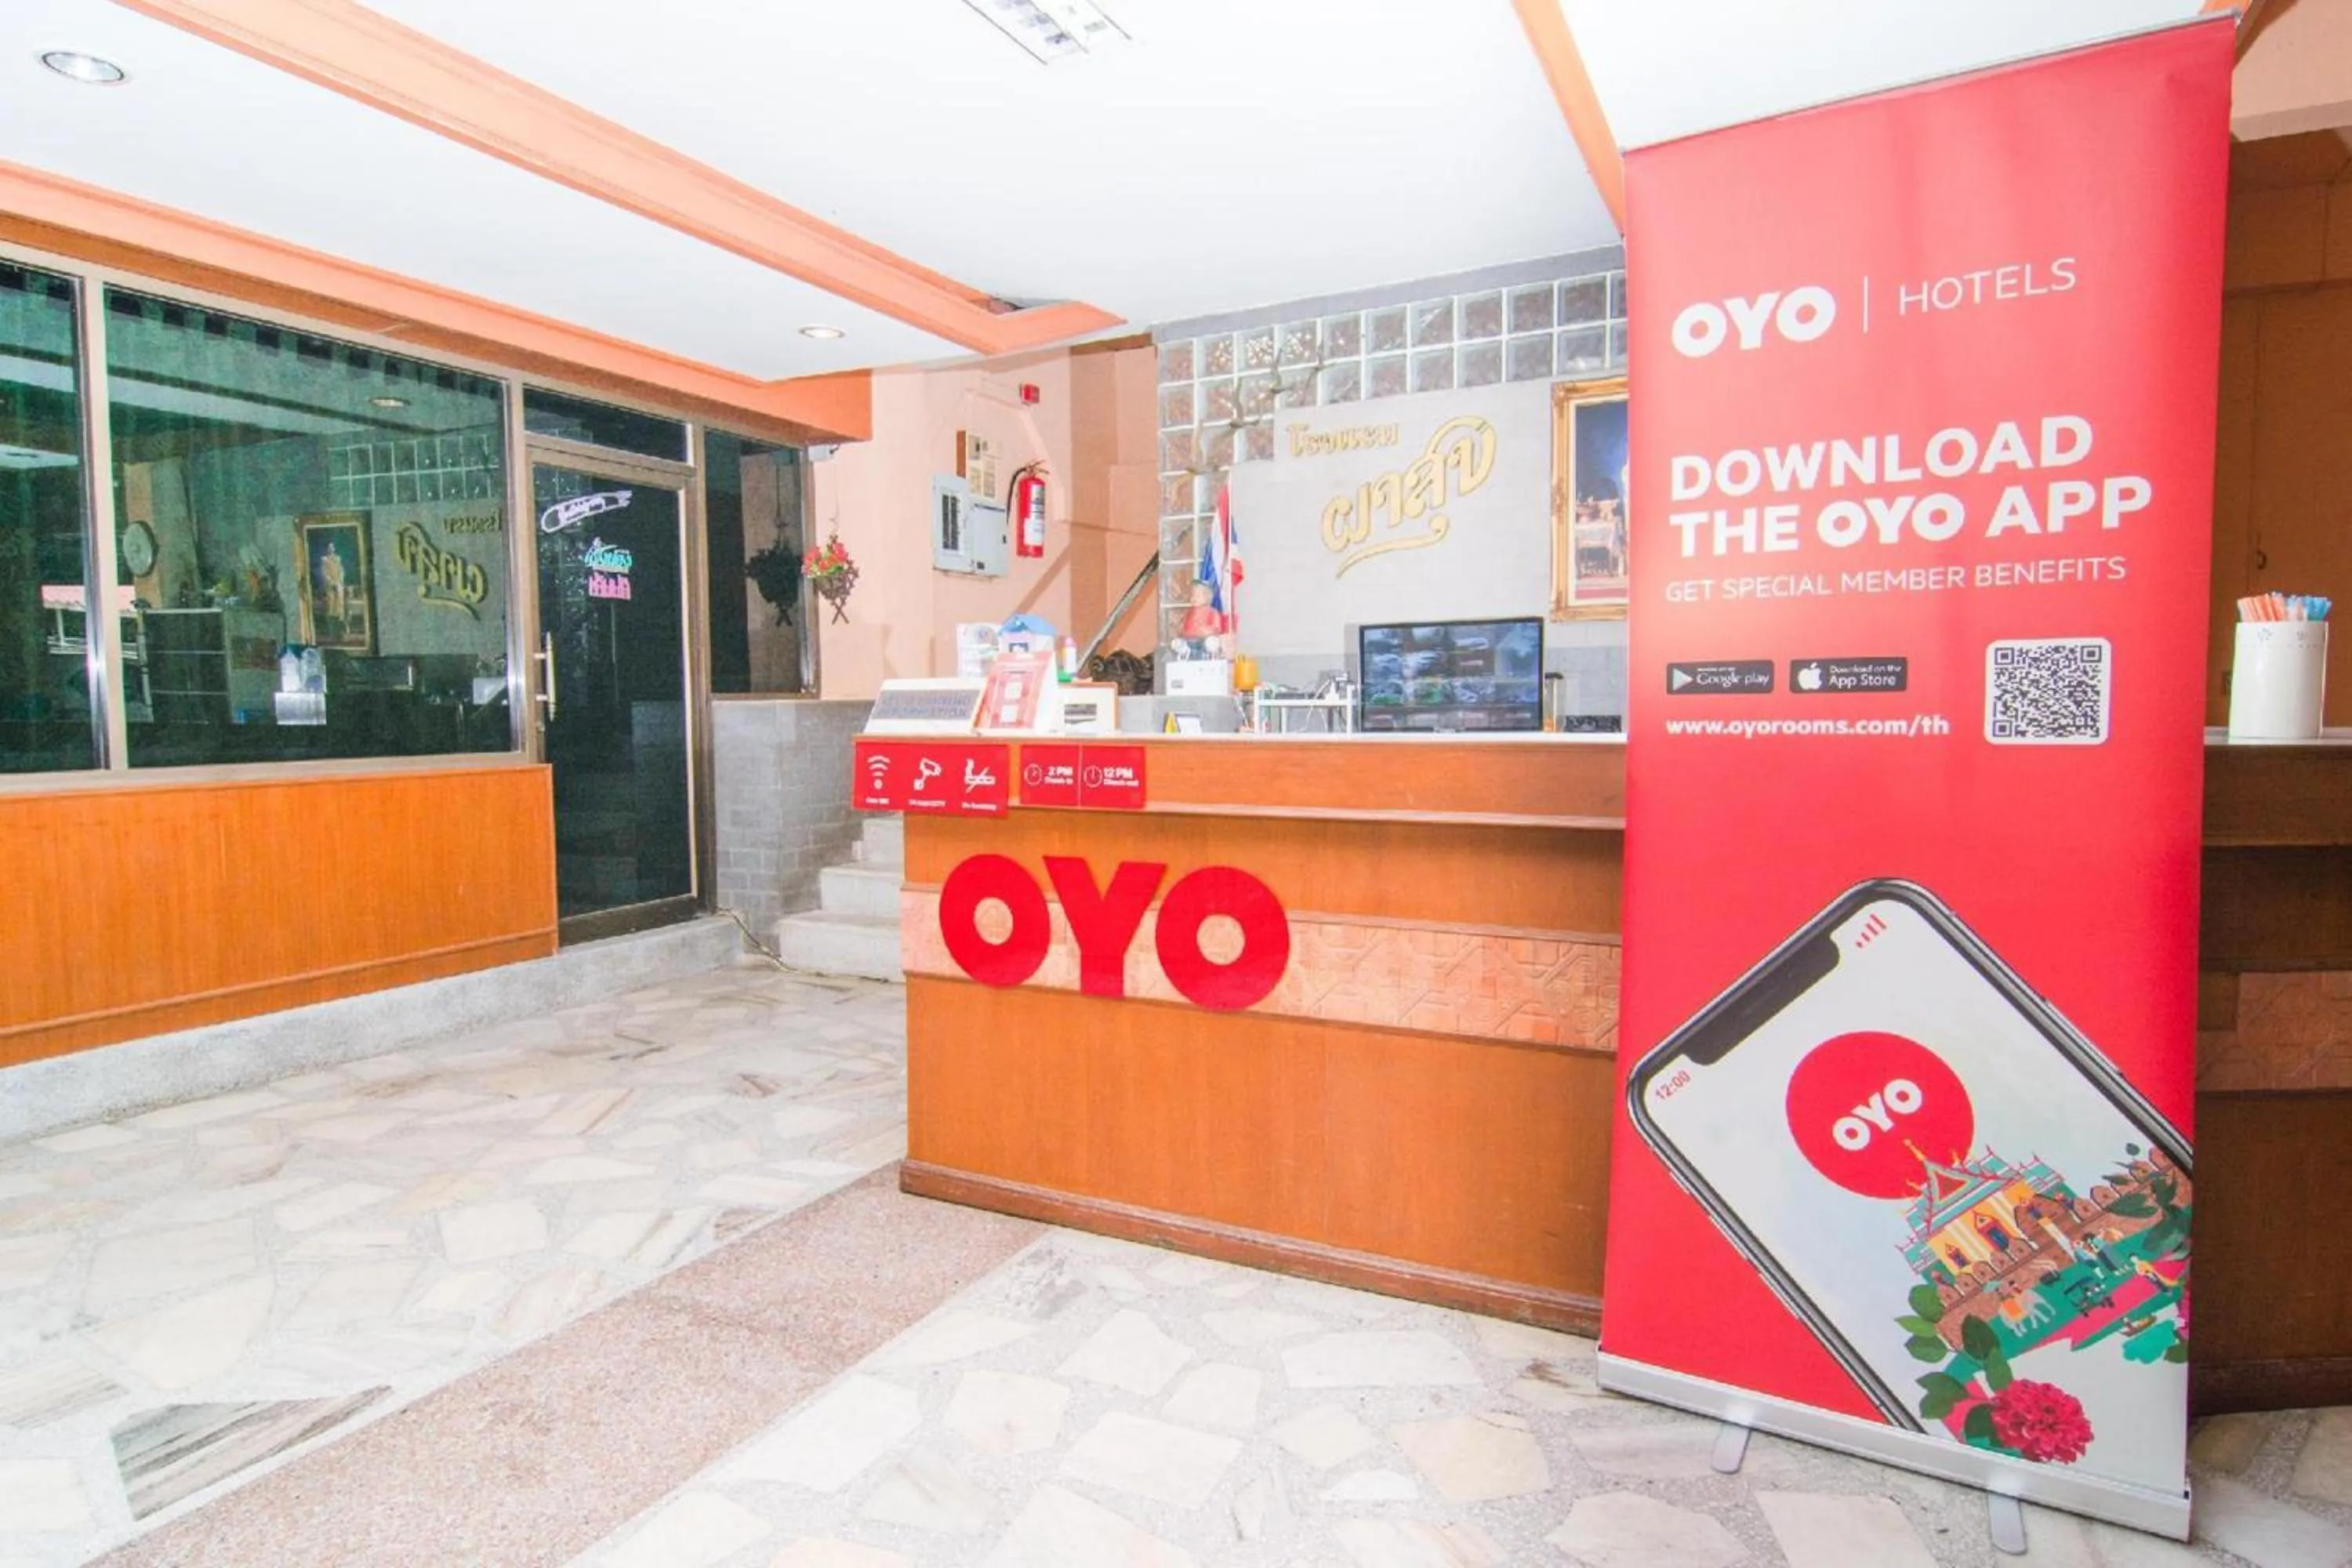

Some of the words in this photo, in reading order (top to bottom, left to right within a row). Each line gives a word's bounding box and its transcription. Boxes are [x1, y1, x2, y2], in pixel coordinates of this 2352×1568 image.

[1671, 285, 1836, 358] OYO
[1898, 257, 2078, 316] HOTELS
[1671, 415, 2093, 502] DOWNLOAD
[1669, 504, 1800, 558] THE
[1816, 493, 1965, 547] OYO
[1984, 475, 2153, 538] APP
[1666, 579, 1712, 602] GET
[1722, 574, 1832, 599] SPECIAL
[1841, 566, 1965, 593] MEMBER
[1975, 556, 2127, 586] BENEFITS
[1744, 671, 1769, 686] play
[1829, 674, 1857, 689] App
[1860, 673, 1896, 686] Store
[1665, 715, 1950, 739] www.oyorooms.com/th
[939, 853, 1290, 1013] OYO
[1654, 1070, 1691, 1100] 12:00
[1832, 1078, 1923, 1151] OYO
